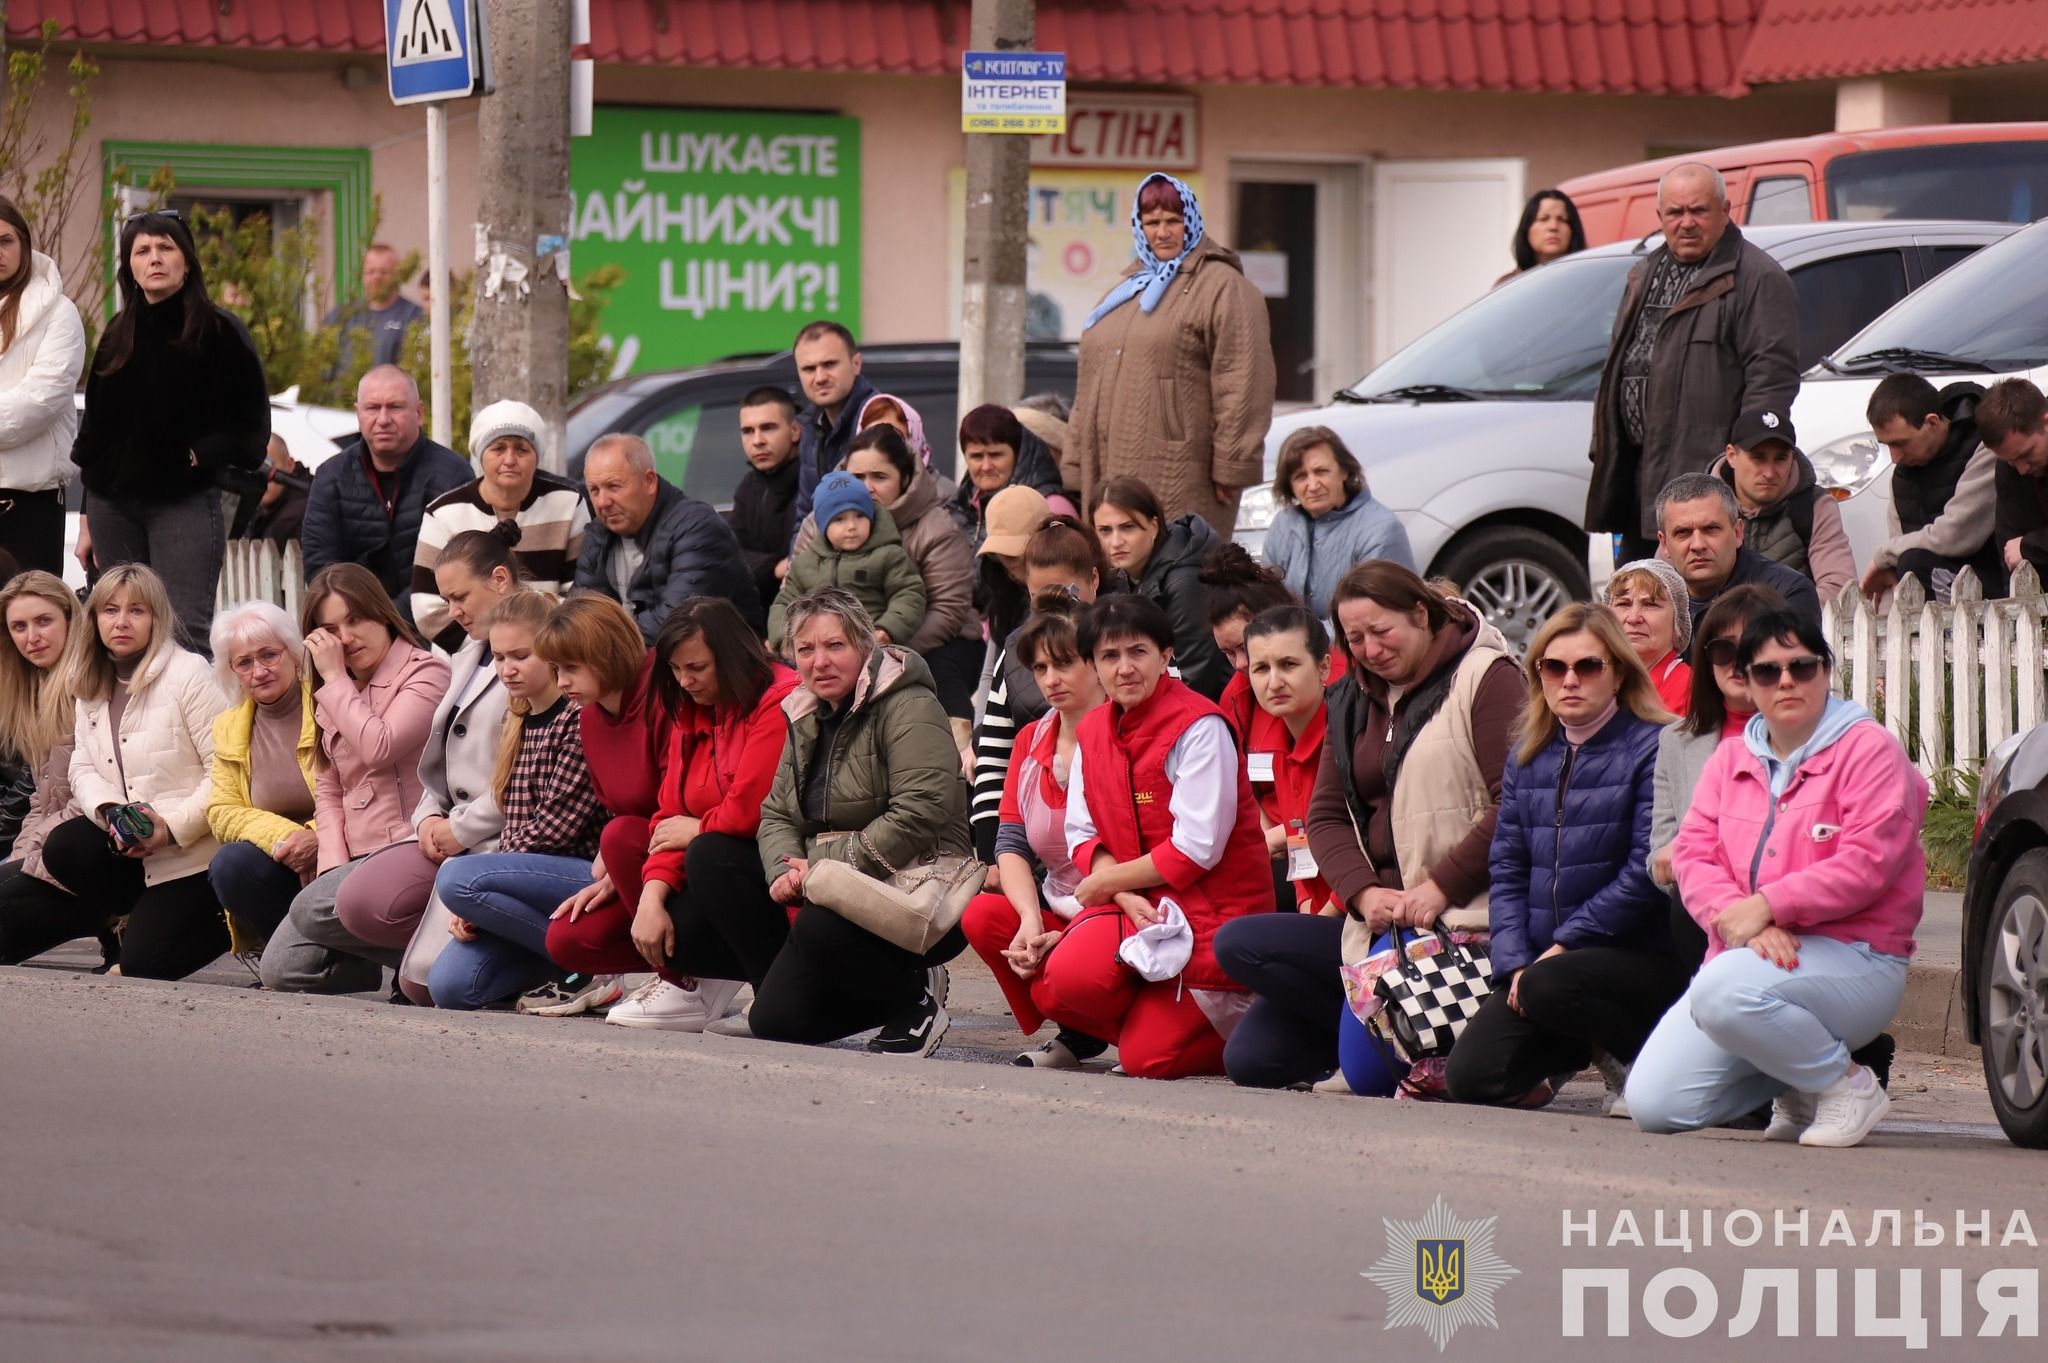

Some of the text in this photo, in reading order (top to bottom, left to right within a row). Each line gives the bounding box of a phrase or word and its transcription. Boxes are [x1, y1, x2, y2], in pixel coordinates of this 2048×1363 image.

[968, 85, 1060, 99] ІНТЕРНЕТ
[641, 131, 838, 177] ШУКАЄТЕ
[570, 179, 839, 246] АЙНИЖЧІ
[659, 258, 839, 319] ЦІНИ?!
